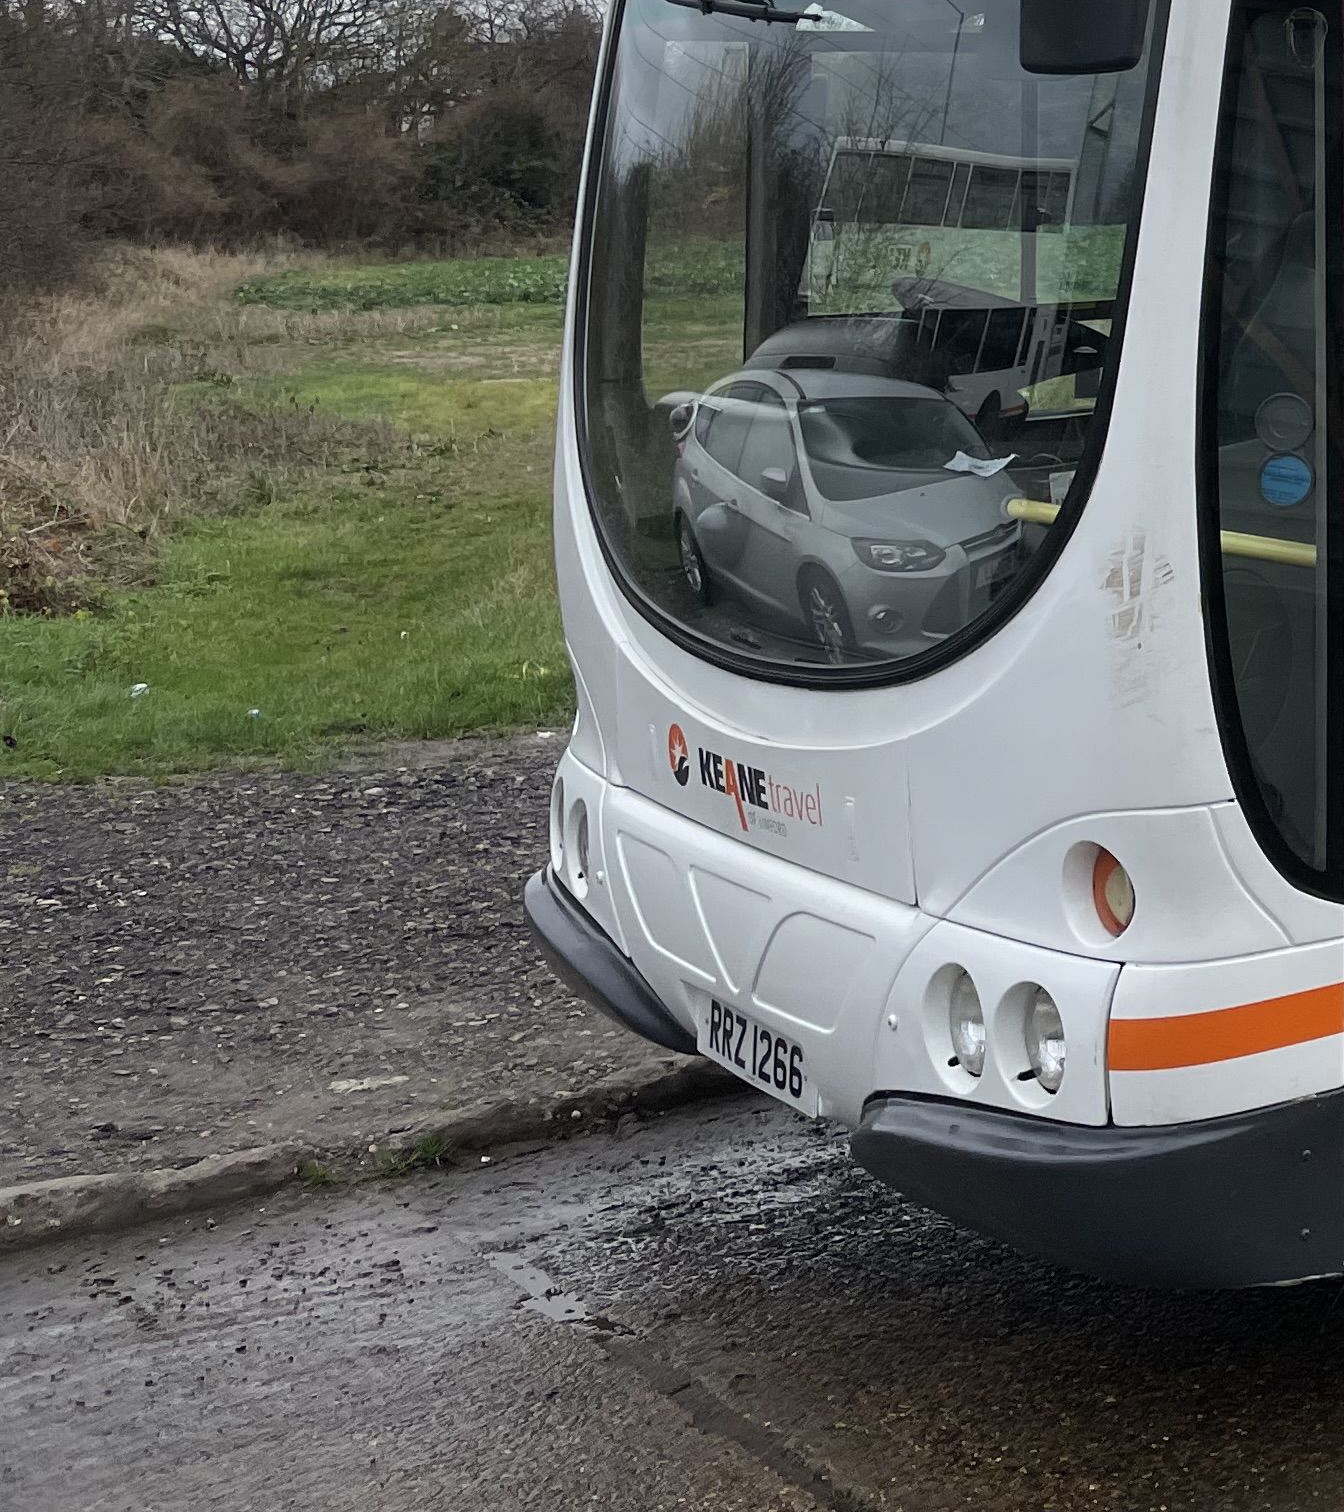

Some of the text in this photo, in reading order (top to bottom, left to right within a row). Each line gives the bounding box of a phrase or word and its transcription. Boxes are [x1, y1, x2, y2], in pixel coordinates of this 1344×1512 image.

[698, 747, 822, 832] KEANE travel
[709, 998, 803, 1099] RRZ 1266
